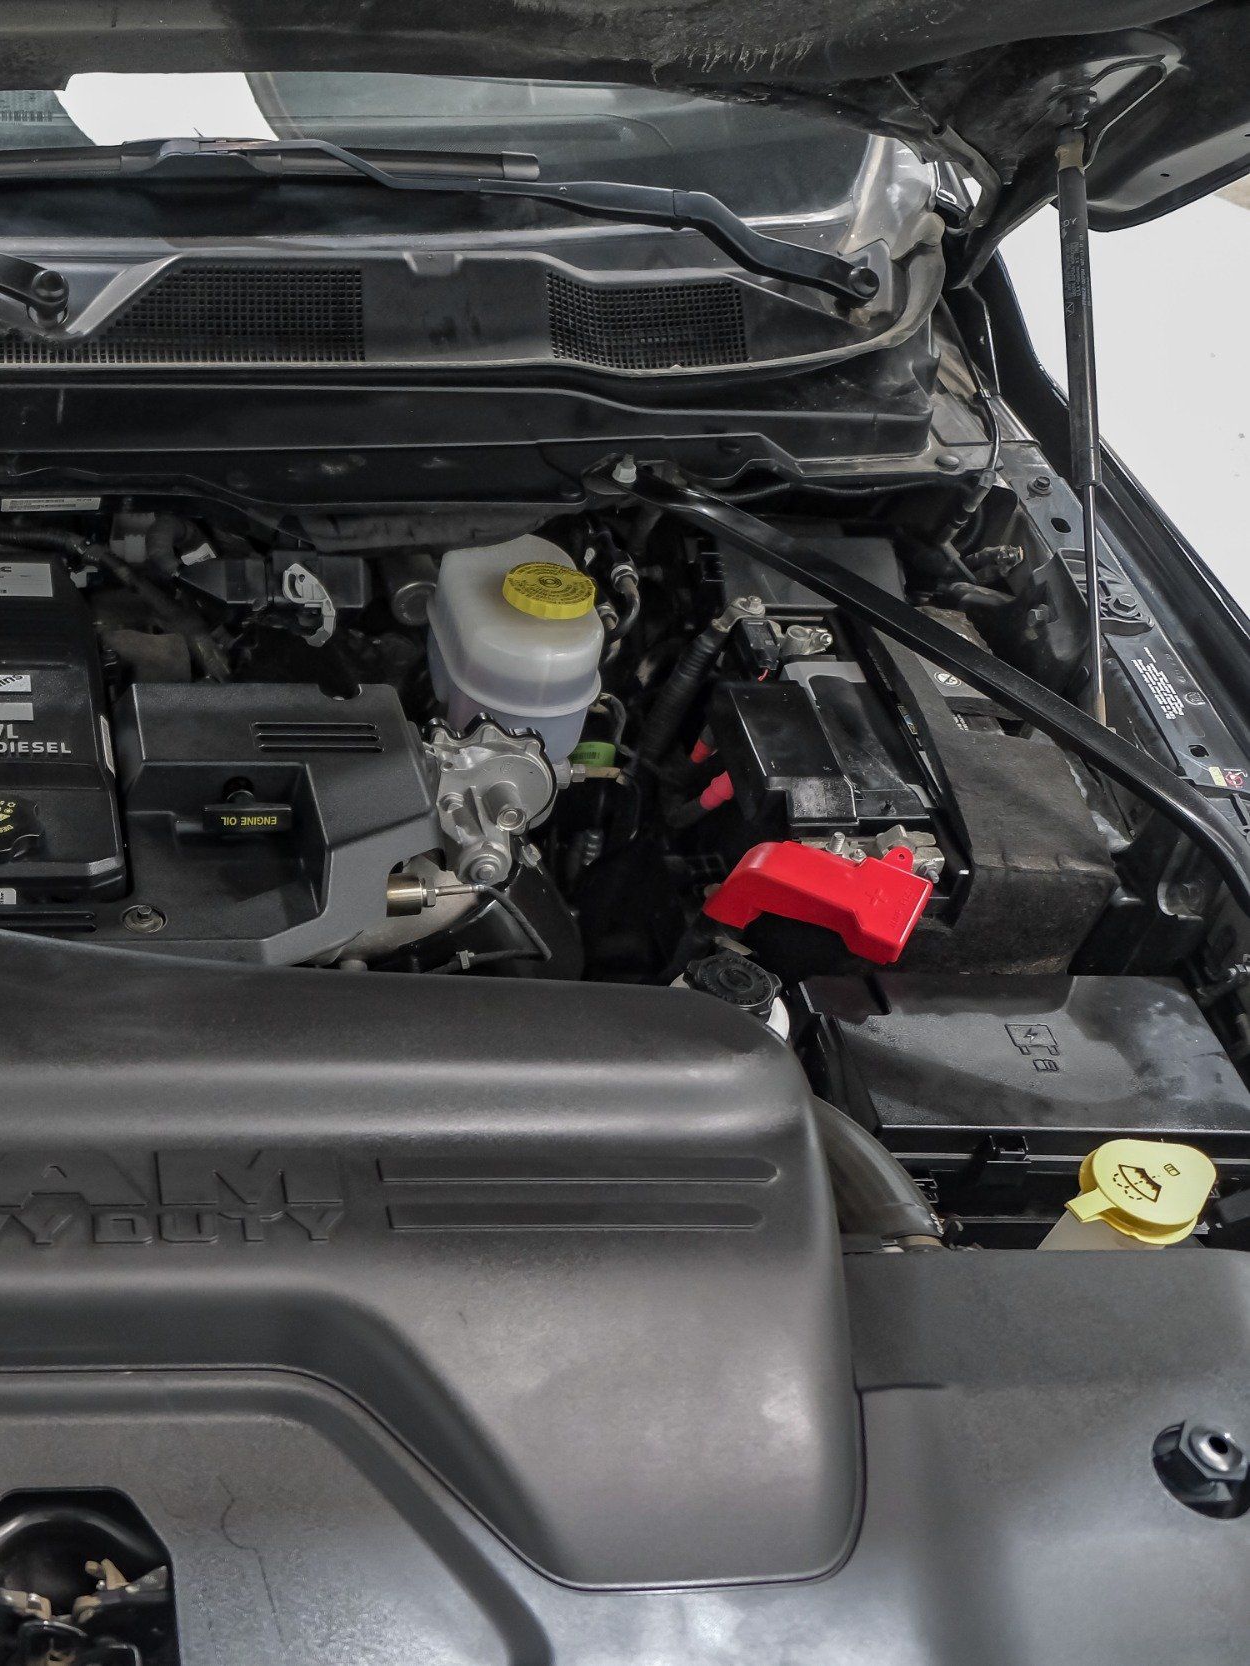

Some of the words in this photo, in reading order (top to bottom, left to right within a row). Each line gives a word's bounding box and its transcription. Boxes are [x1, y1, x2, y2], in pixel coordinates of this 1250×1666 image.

[220, 816, 237, 826] OIL
[240, 816, 277, 826] ENGINE
[91, 1211, 344, 1244] DUTY
